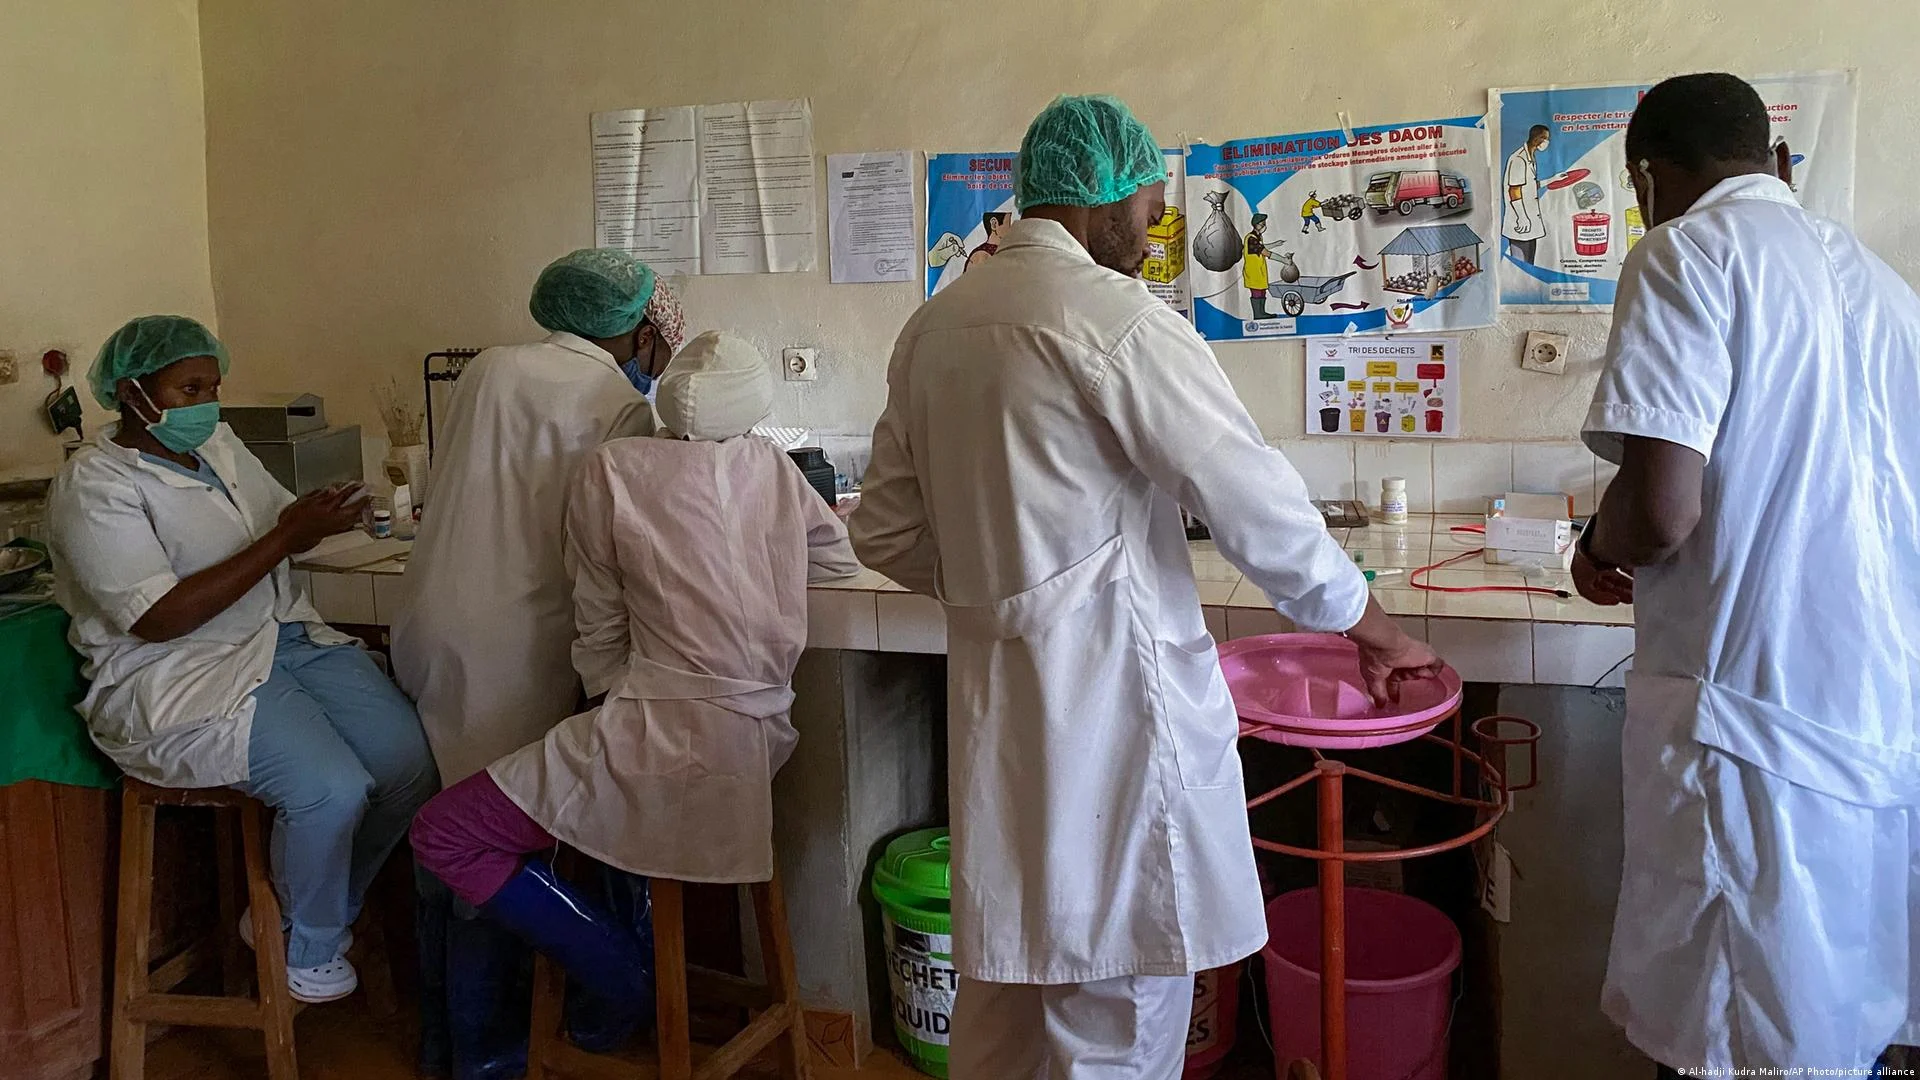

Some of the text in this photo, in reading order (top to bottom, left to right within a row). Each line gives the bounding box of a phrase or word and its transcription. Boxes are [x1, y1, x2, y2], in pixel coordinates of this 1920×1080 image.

[1554, 113, 1601, 121] Respecter
[1576, 123, 1590, 131] les
[1222, 135, 1341, 160] ELIMINATION
[1388, 125, 1443, 143] DAOM
[1317, 159, 1349, 168] stockage
[1438, 148, 1467, 157] sécurisé
[1323, 151, 1350, 160] Ordures
[1389, 145, 1415, 153] doivent
[1417, 143, 1432, 151] aller
[1348, 346, 1416, 354] TRI DES DECHETS
[888, 951, 960, 992] ECHET
